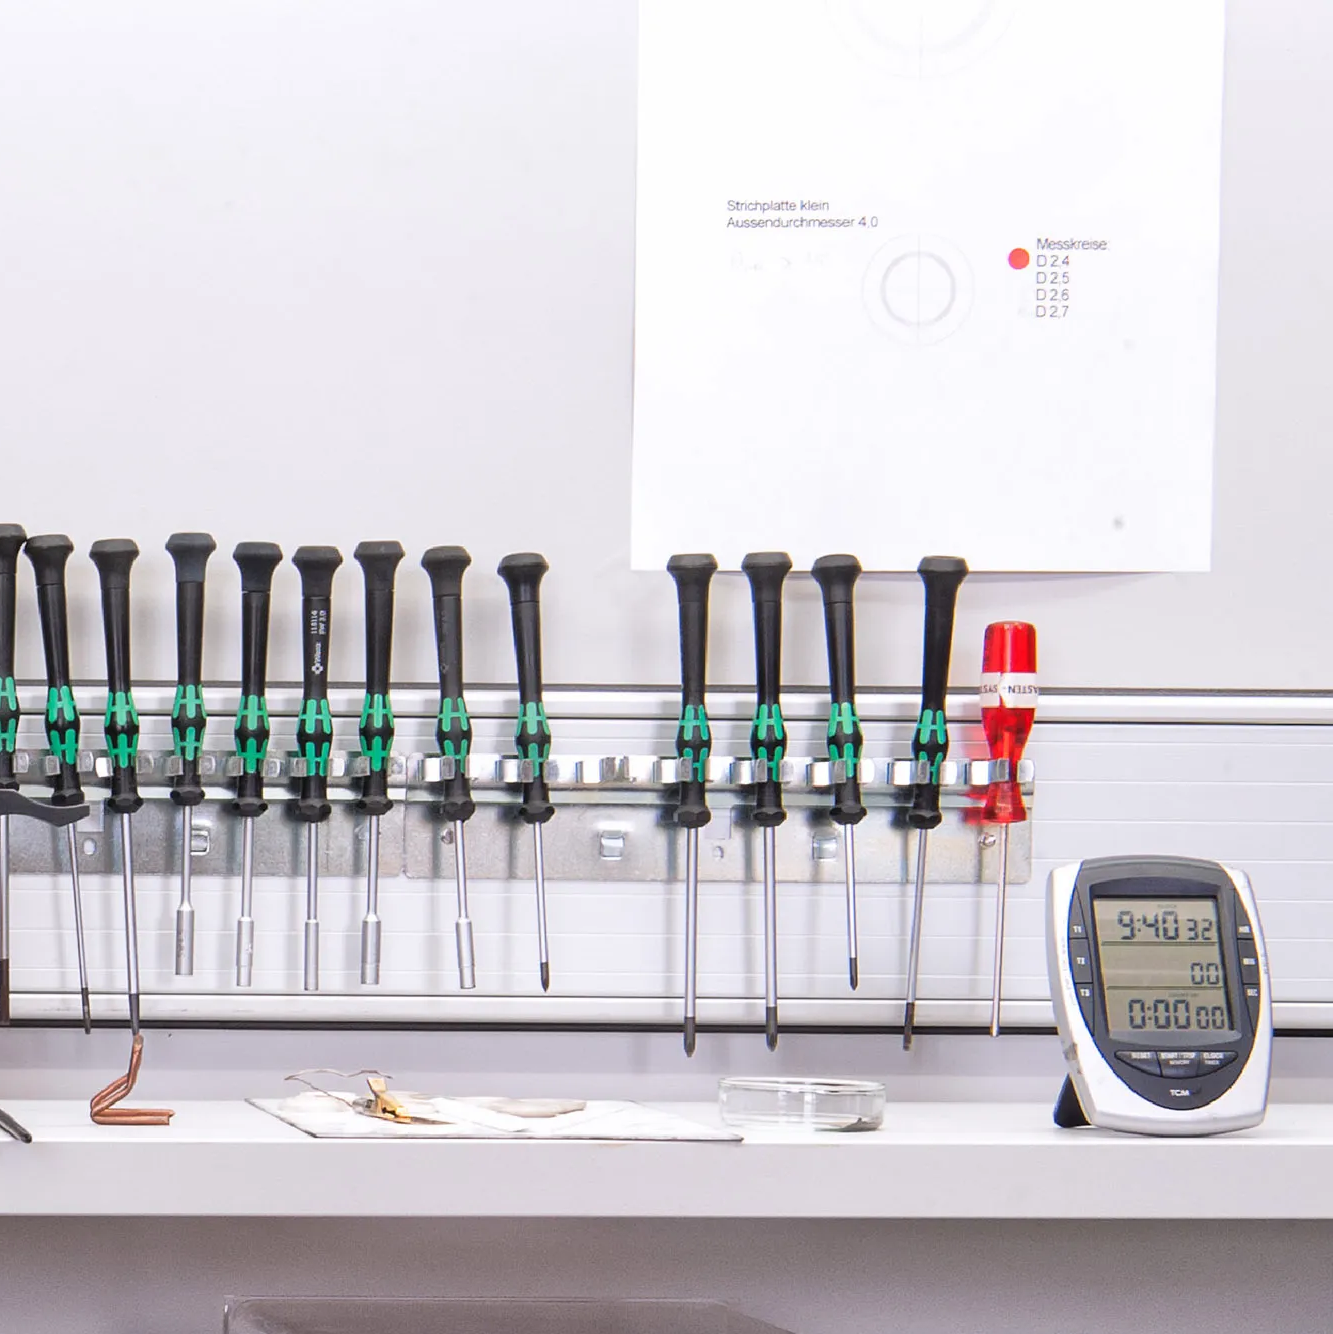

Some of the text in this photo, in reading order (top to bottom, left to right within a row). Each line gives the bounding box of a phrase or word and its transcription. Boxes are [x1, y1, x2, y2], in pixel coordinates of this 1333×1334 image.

[727, 200, 829, 214] Strichplatte klein
[726, 216, 878, 228] Aussendurchmesser 4,0
[1036, 255, 1069, 268] D 2,4
[1036, 272, 1069, 286] D 2,5
[1036, 288, 1069, 302] D 2,6
[1036, 305, 1069, 319] D 2,7
[1117, 911, 1213, 941] 9:40 32
[1190, 962, 1220, 985] 00
[1128, 999, 1225, 1030] 0:00 00
